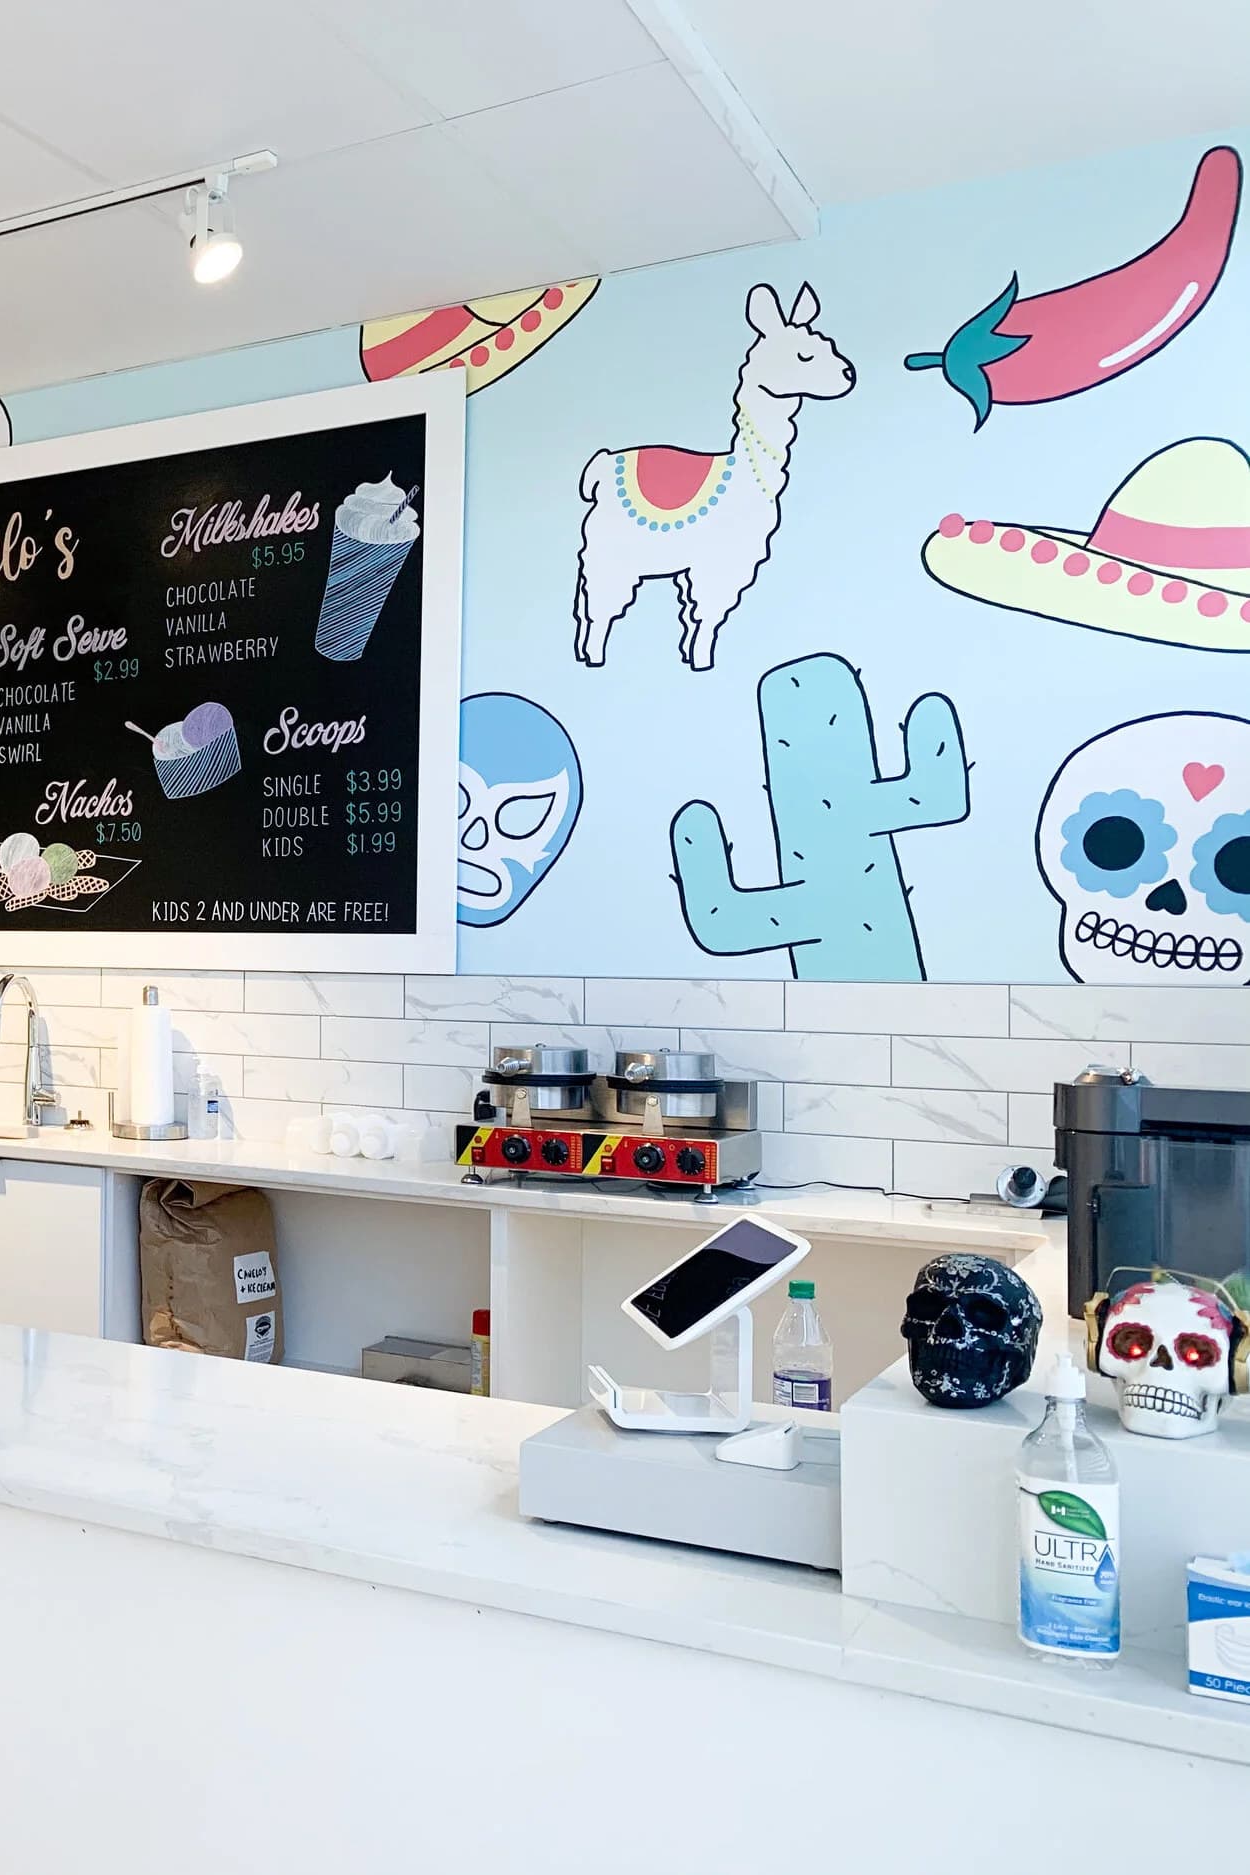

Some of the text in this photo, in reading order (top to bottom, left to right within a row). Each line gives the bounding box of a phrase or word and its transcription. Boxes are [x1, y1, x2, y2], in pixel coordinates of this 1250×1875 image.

[161, 491, 320, 558] Milkshakes
[252, 542, 305, 570] $5.95
[166, 577, 256, 608] CHOCOLATE
[52, 614, 128, 661] Serve
[166, 611, 227, 637] VANILLA
[165, 636, 279, 669] STRAWBERRY
[93, 658, 139, 683] $2.99
[263, 706, 367, 755] Scoops
[262, 768, 402, 797] SINGLE $3.99
[35, 777, 134, 825] Nachos
[262, 801, 402, 828] DOUBLE $5.99
[95, 821, 142, 844] $7.50
[262, 831, 396, 857] KIDS $1.99
[152, 900, 389, 923] KIDS 2 AND UNDER ARE FREE!
[1034, 1535, 1115, 1562] ULTRA
[1205, 1676, 1221, 1689] 50
